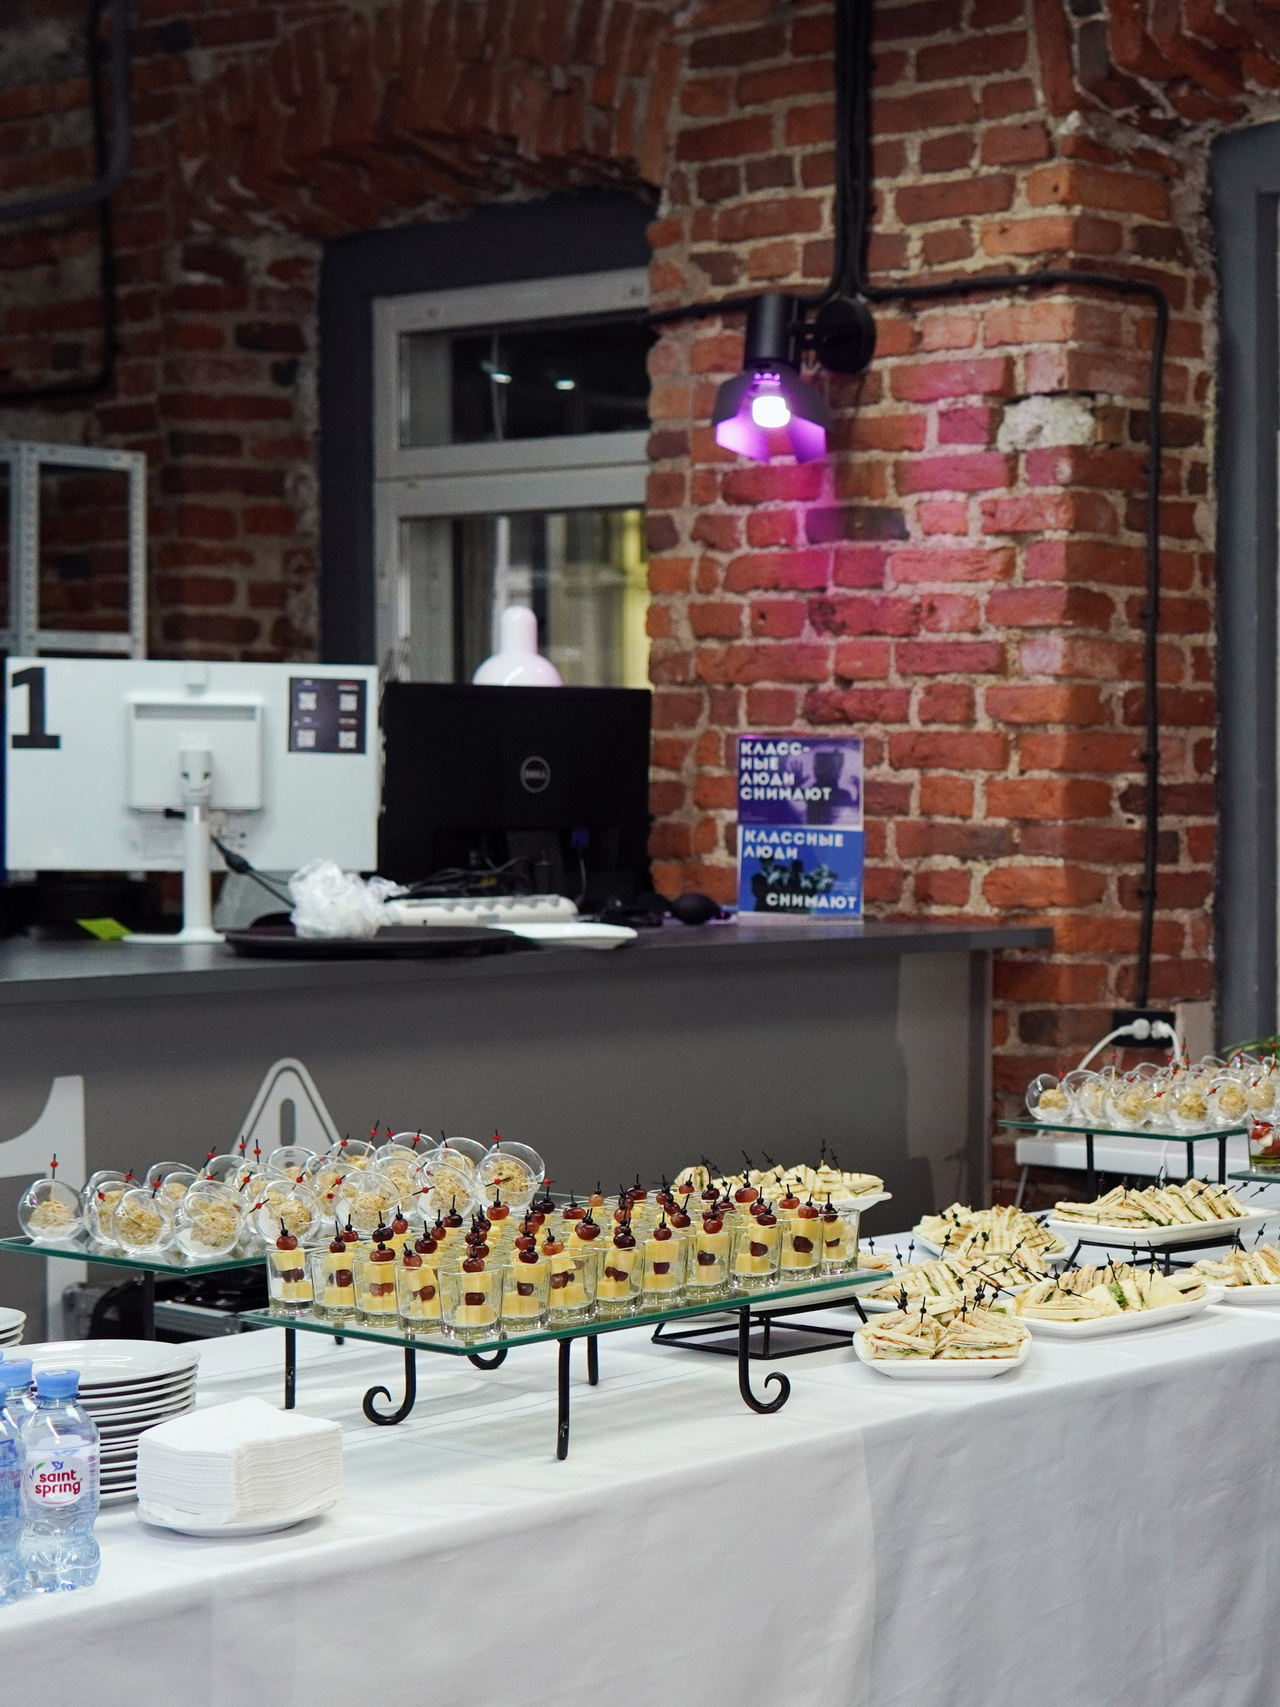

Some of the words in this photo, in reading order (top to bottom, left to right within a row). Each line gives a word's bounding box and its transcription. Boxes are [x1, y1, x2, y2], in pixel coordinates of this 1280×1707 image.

[11, 666, 61, 749] 1
[740, 757, 779, 771] НЫЕ
[740, 772, 796, 786] ЛЮДИ
[740, 787, 832, 801] СНИМАЮТ
[744, 829, 844, 847] КЛАССНЫЕ
[743, 845, 798, 860] ЛЮДИ
[766, 892, 857, 909] СНИМАЮТ
[39, 1469, 77, 1483] saint
[35, 1481, 81, 1497] spring
